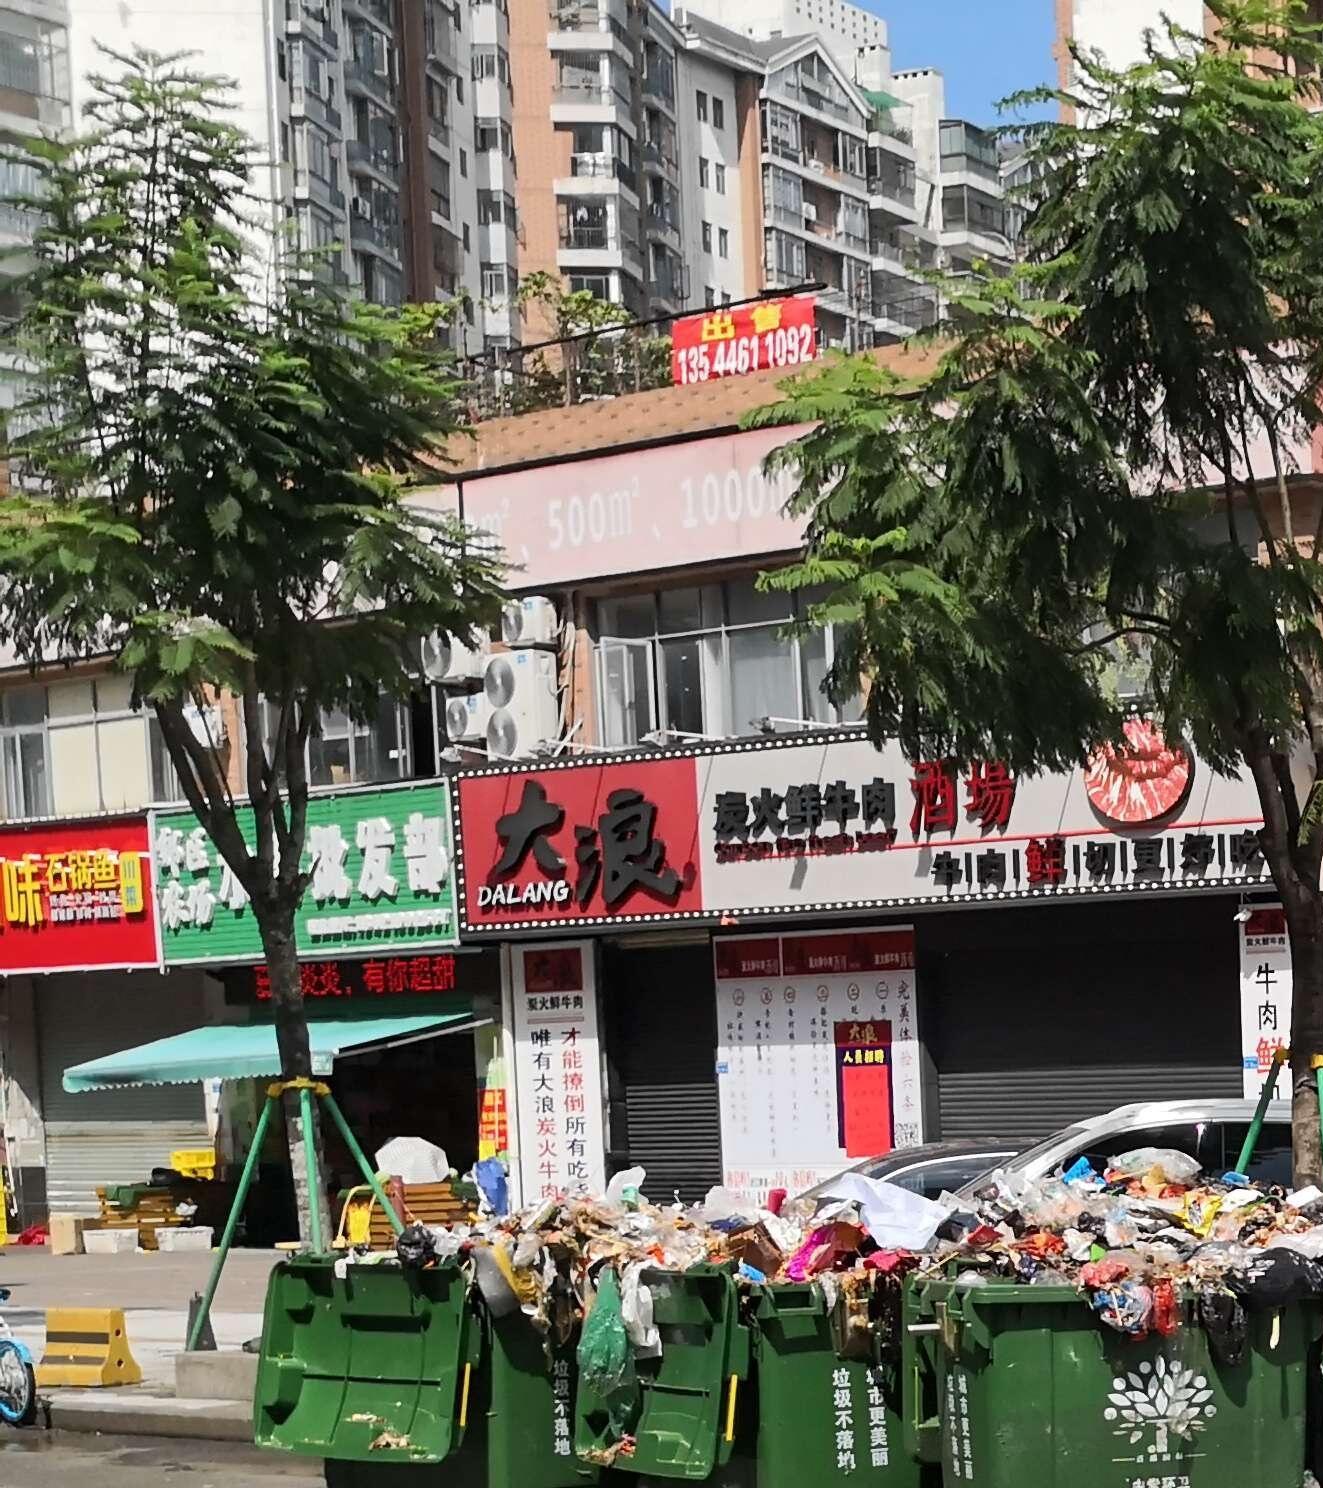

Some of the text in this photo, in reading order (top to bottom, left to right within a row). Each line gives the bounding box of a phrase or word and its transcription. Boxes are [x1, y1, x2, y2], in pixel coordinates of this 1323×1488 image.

[701, 303, 783, 342] 出售
[678, 323, 813, 384] 135 4461 1092
[45, 850, 118, 892] 石锅鱼
[494, 779, 683, 908] 大浪
[477, 880, 570, 908] DALANG
[554, 1360, 571, 1456] 垃圾不落地
[833, 1368, 856, 1470] 垃圾不落地
